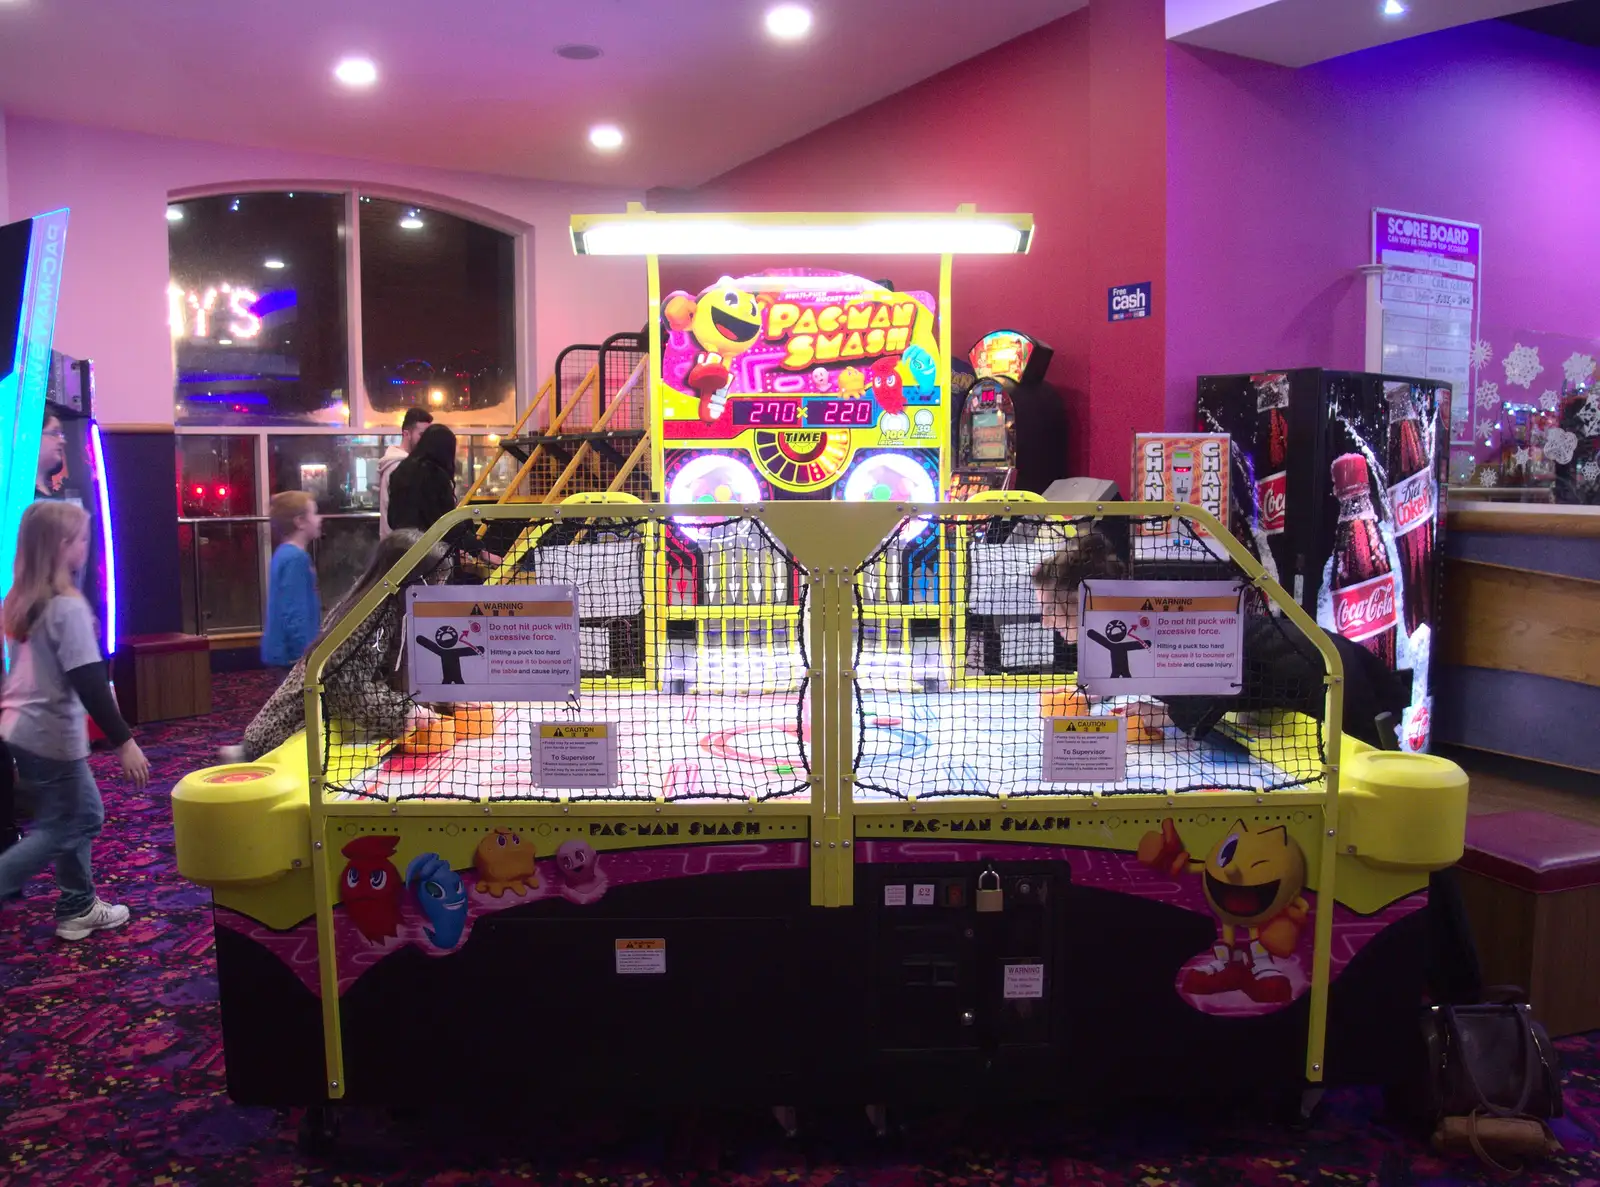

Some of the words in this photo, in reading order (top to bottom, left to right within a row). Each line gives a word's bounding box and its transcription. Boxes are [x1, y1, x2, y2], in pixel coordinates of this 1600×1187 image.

[1387, 217, 1429, 240] SCORE
[1430, 223, 1469, 246] BOARD
[1112, 288, 1127, 296] Free
[1112, 288, 1146, 311] cash
[782, 327, 911, 370] SMASH
[750, 403, 796, 423] 270
[824, 402, 870, 422] 220
[784, 432, 821, 443] TIME
[1144, 442, 1164, 531] CHANE
[1337, 583, 1393, 631] Coca-Cola
[489, 623, 501, 631] Do
[503, 623, 517, 631] not
[519, 623, 530, 631] hit
[532, 623, 553, 631] puck
[554, 623, 573, 631] with
[1186, 617, 1196, 625] hit
[1198, 617, 1217, 626] puck
[1219, 617, 1237, 625] with
[532, 633, 557, 641] force.
[560, 754, 596, 762] Supervisor
[1072, 748, 1106, 756] Supervisor
[589, 822, 679, 836] PAC-MAN
[688, 821, 760, 836] SMASH
[902, 818, 991, 833] PAC-MAN
[1000, 816, 1071, 831] SMASH
[918, 887, 931, 896] £2
[1007, 966, 1040, 974] WARNING
